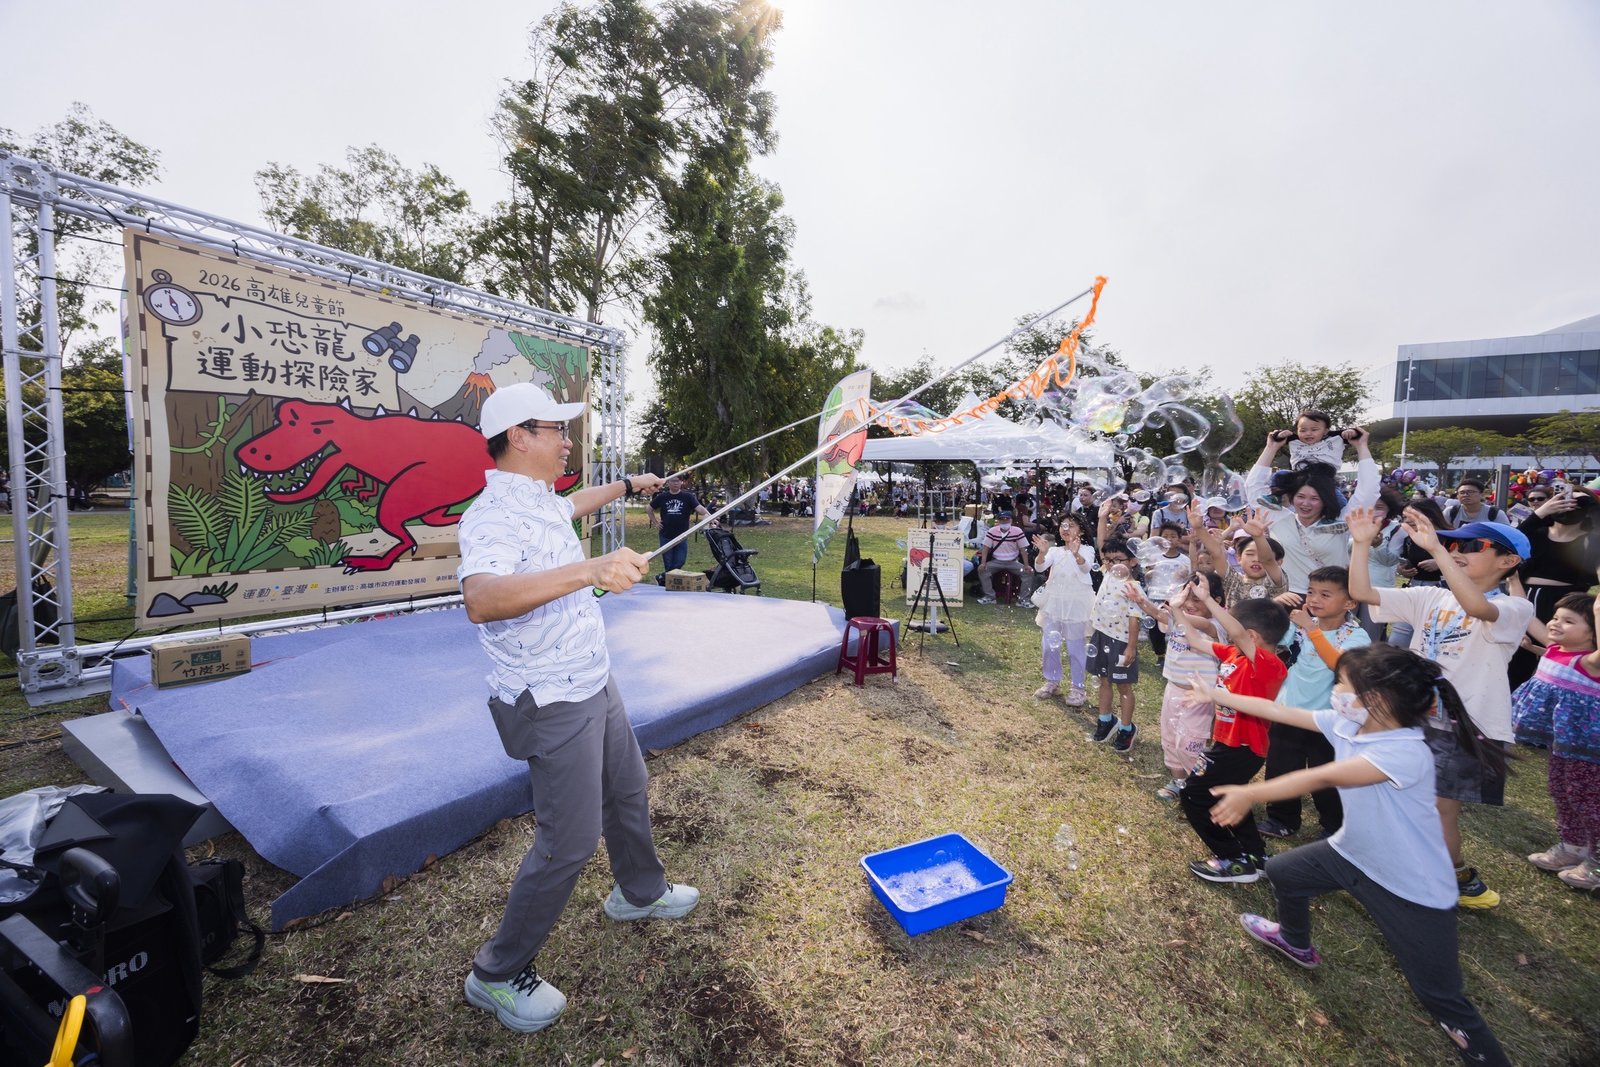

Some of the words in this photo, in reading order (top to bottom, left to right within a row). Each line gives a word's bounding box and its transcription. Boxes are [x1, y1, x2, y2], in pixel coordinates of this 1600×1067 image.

[198, 269, 241, 292] 2026
[246, 278, 345, 317] 高雄兒童節
[220, 314, 355, 362] 小恐龍
[196, 346, 381, 396] 運動探險家
[182, 662, 231, 678] 竹炭水
